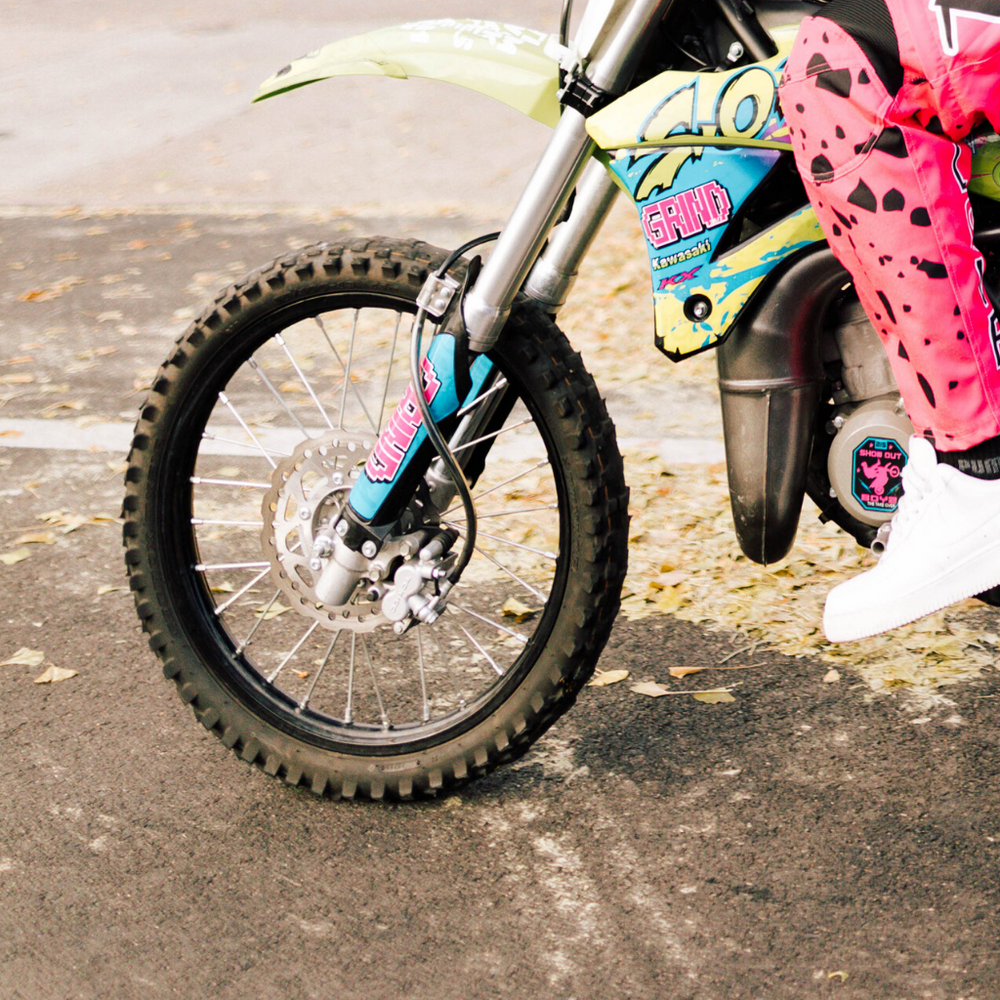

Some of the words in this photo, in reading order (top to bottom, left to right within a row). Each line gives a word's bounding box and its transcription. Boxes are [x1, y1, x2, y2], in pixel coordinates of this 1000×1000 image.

[642, 179, 733, 250] GRIND
[652, 238, 711, 271] Kawasaki
[657, 264, 704, 290] KX
[859, 448, 883, 458] SHOW
[884, 451, 902, 460] OUT
